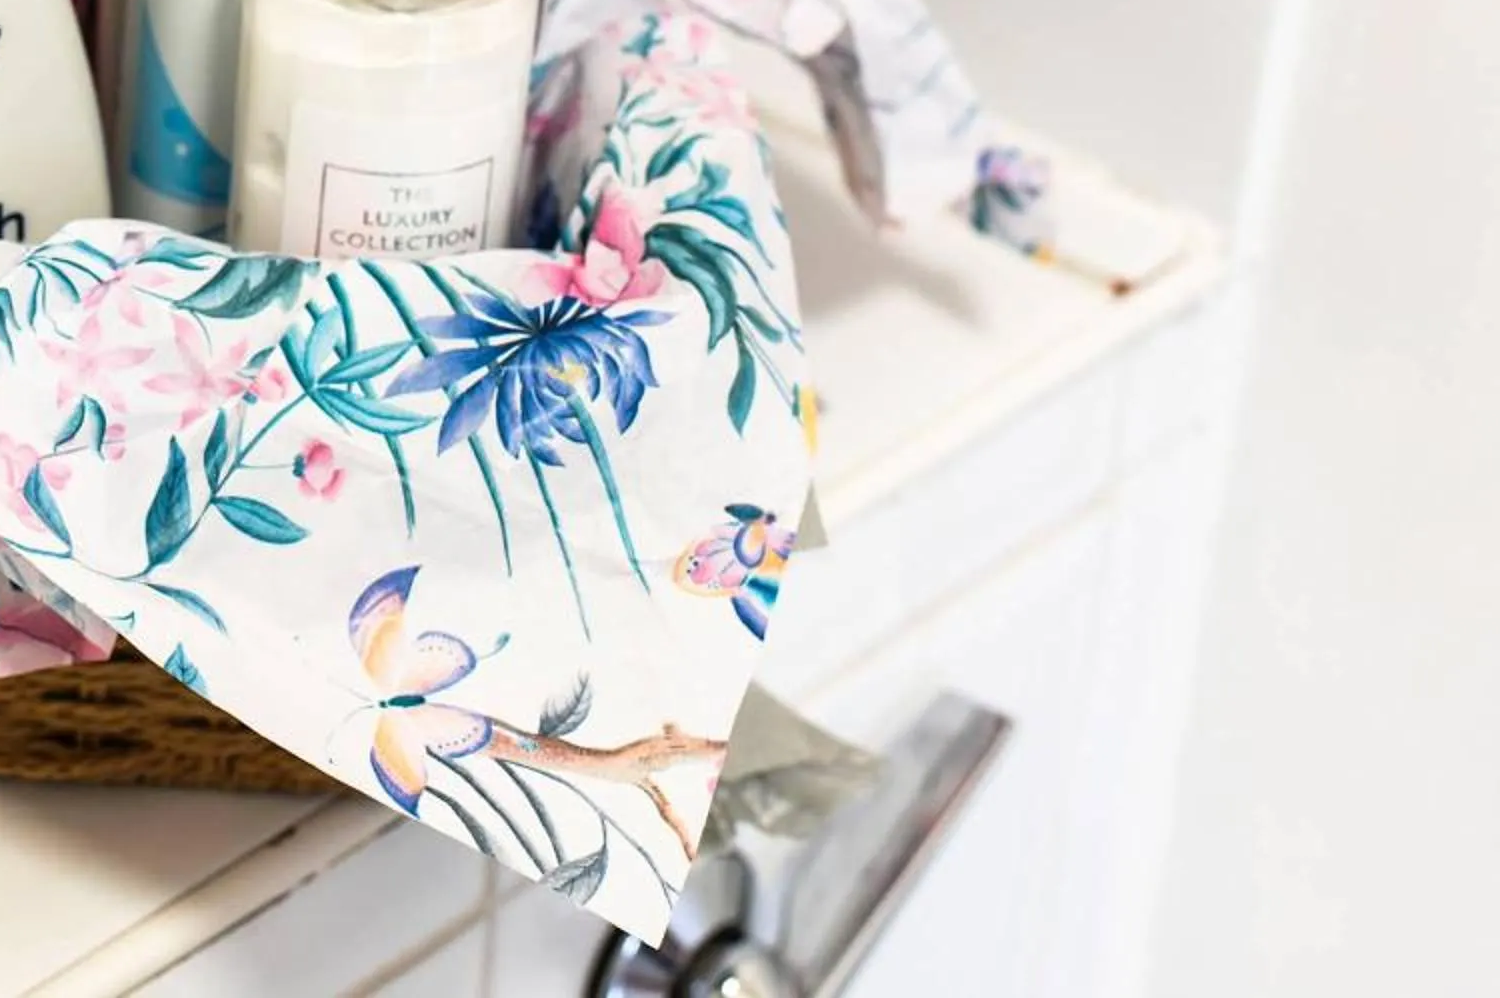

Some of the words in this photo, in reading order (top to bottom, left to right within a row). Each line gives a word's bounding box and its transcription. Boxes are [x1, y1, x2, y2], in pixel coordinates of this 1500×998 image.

[388, 185, 436, 205] TH
[361, 207, 454, 229] LUXURY
[329, 225, 477, 250] COLLECTION
